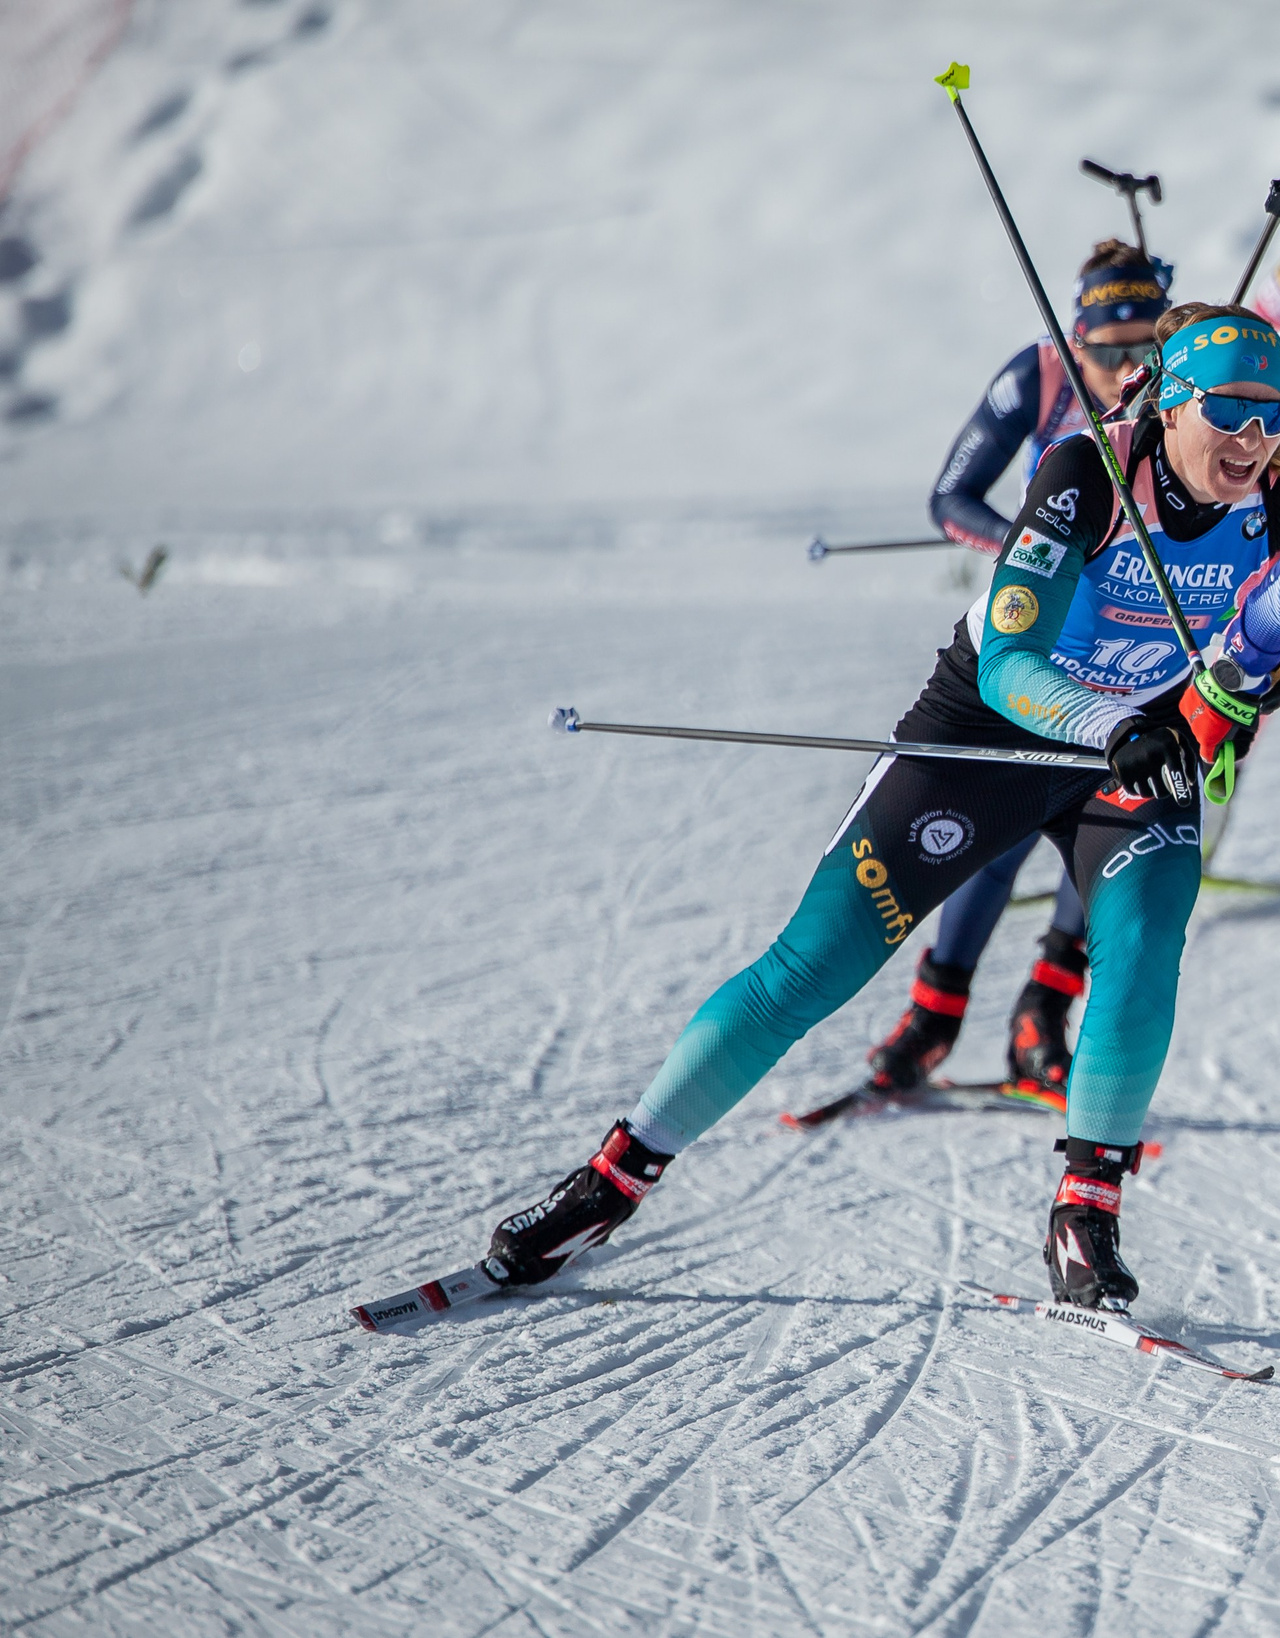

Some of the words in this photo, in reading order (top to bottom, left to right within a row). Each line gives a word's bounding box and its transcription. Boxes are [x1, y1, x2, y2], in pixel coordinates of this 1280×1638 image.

[1035, 506, 1072, 537] odlo
[1097, 581, 1229, 606] ALKOHLFREI
[1114, 611, 1200, 628] GRAPEFIT
[1087, 637, 1177, 675] 10
[910, 810, 943, 831] Région
[1102, 823, 1199, 879] odlo
[852, 838, 914, 945] somfy
[1045, 1308, 1108, 1334] MADSHUS
